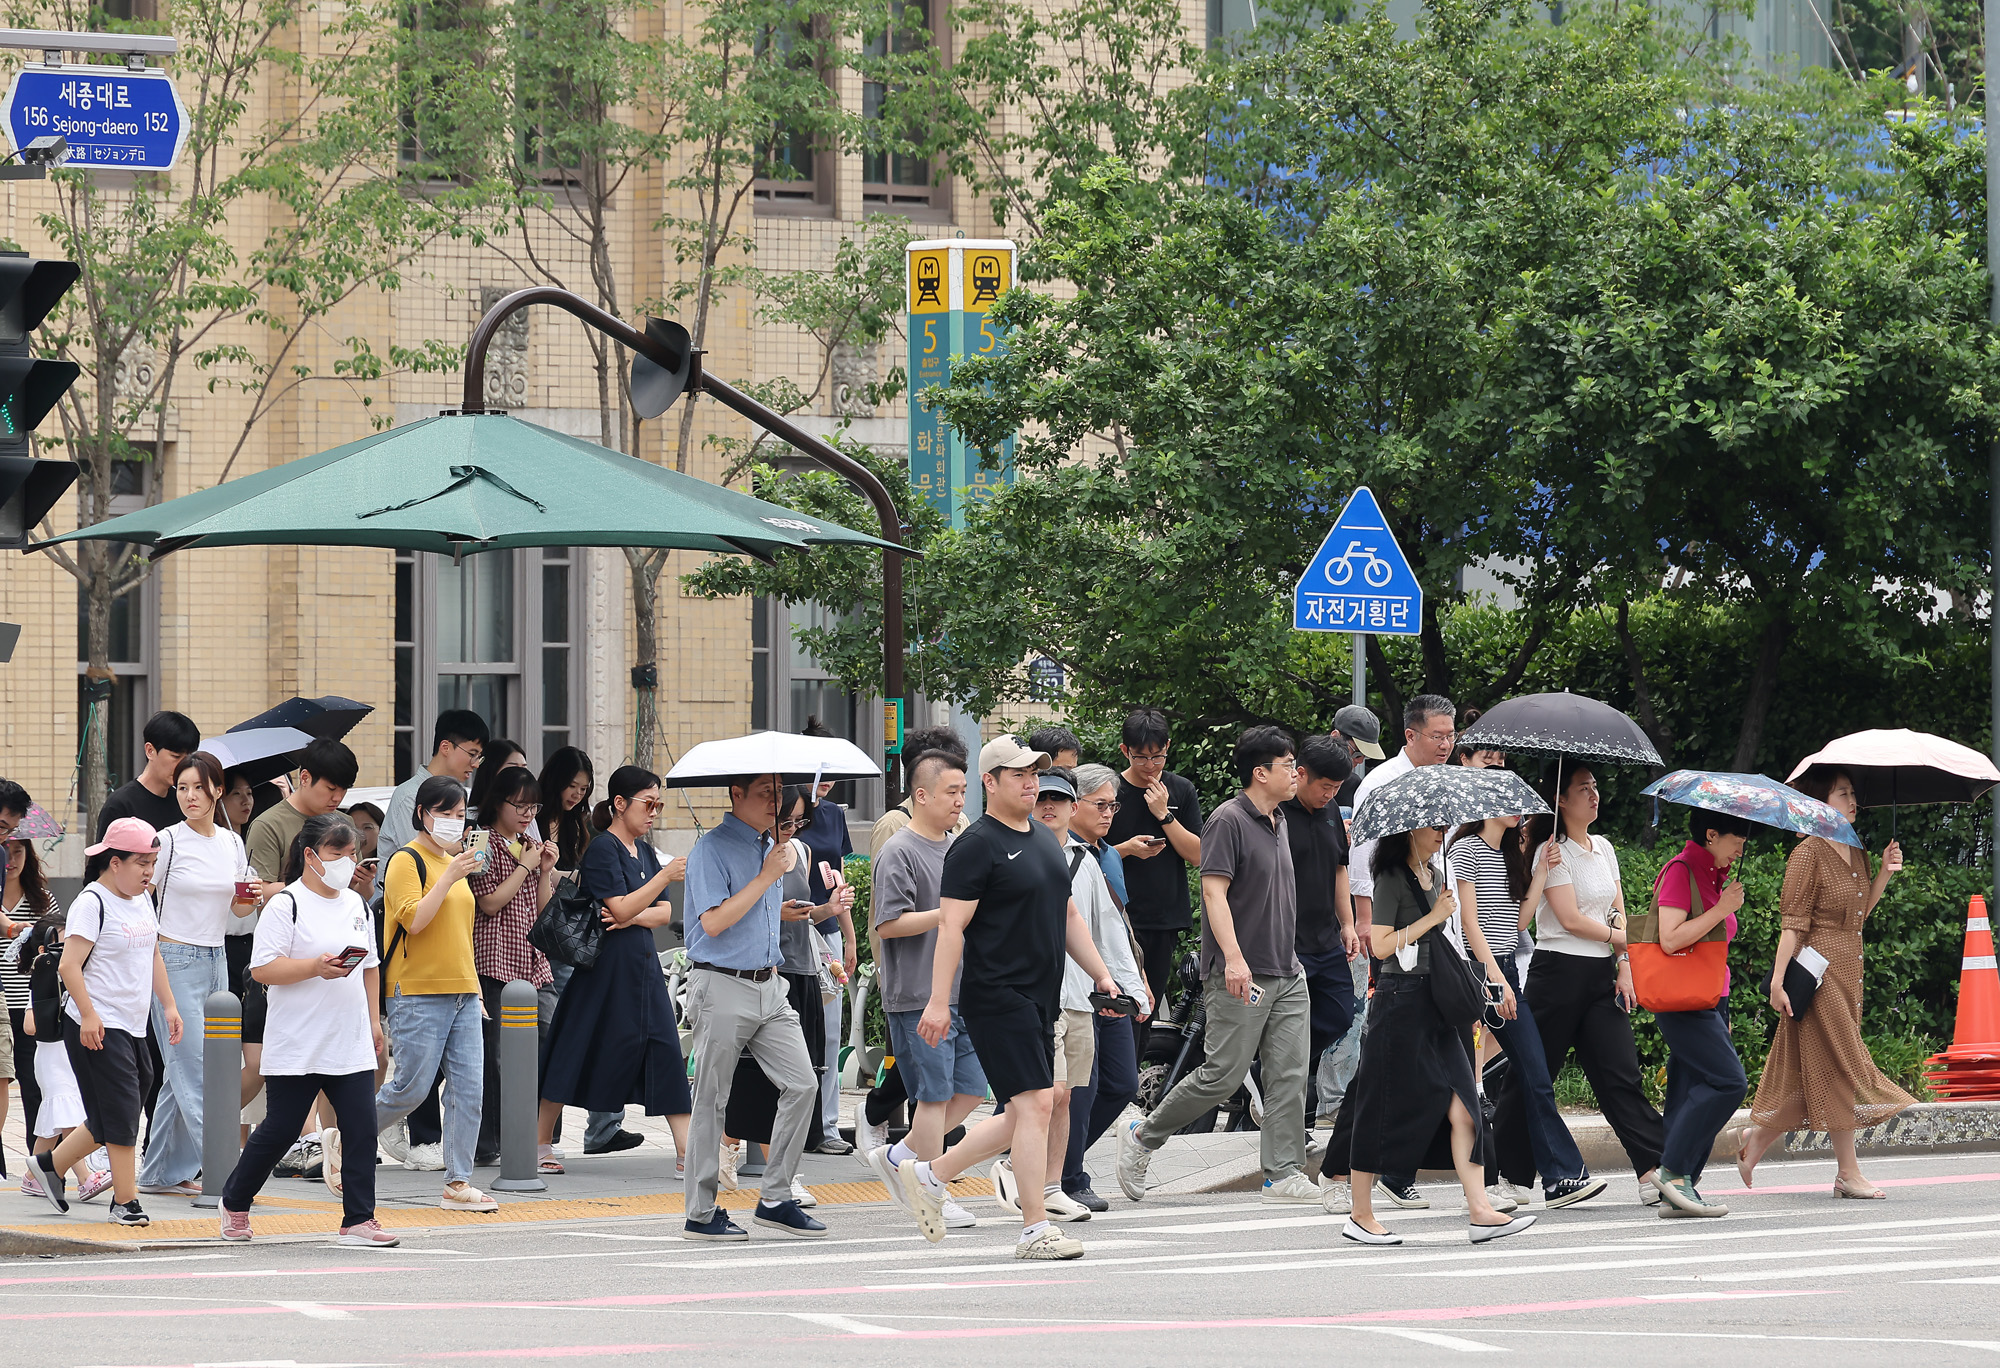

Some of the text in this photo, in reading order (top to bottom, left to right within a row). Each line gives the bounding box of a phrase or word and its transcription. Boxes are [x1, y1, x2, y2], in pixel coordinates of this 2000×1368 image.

[58, 80, 132, 110] 세종대로
[23, 105, 169, 137] 156 Sejong-daero 152
[67, 146, 86, 160] 大路
[93, 147, 146, 162] セジョンデロ
[923, 319, 937, 354] 5
[979, 318, 996, 353] 5
[1304, 597, 1409, 628] 자전거횡단
